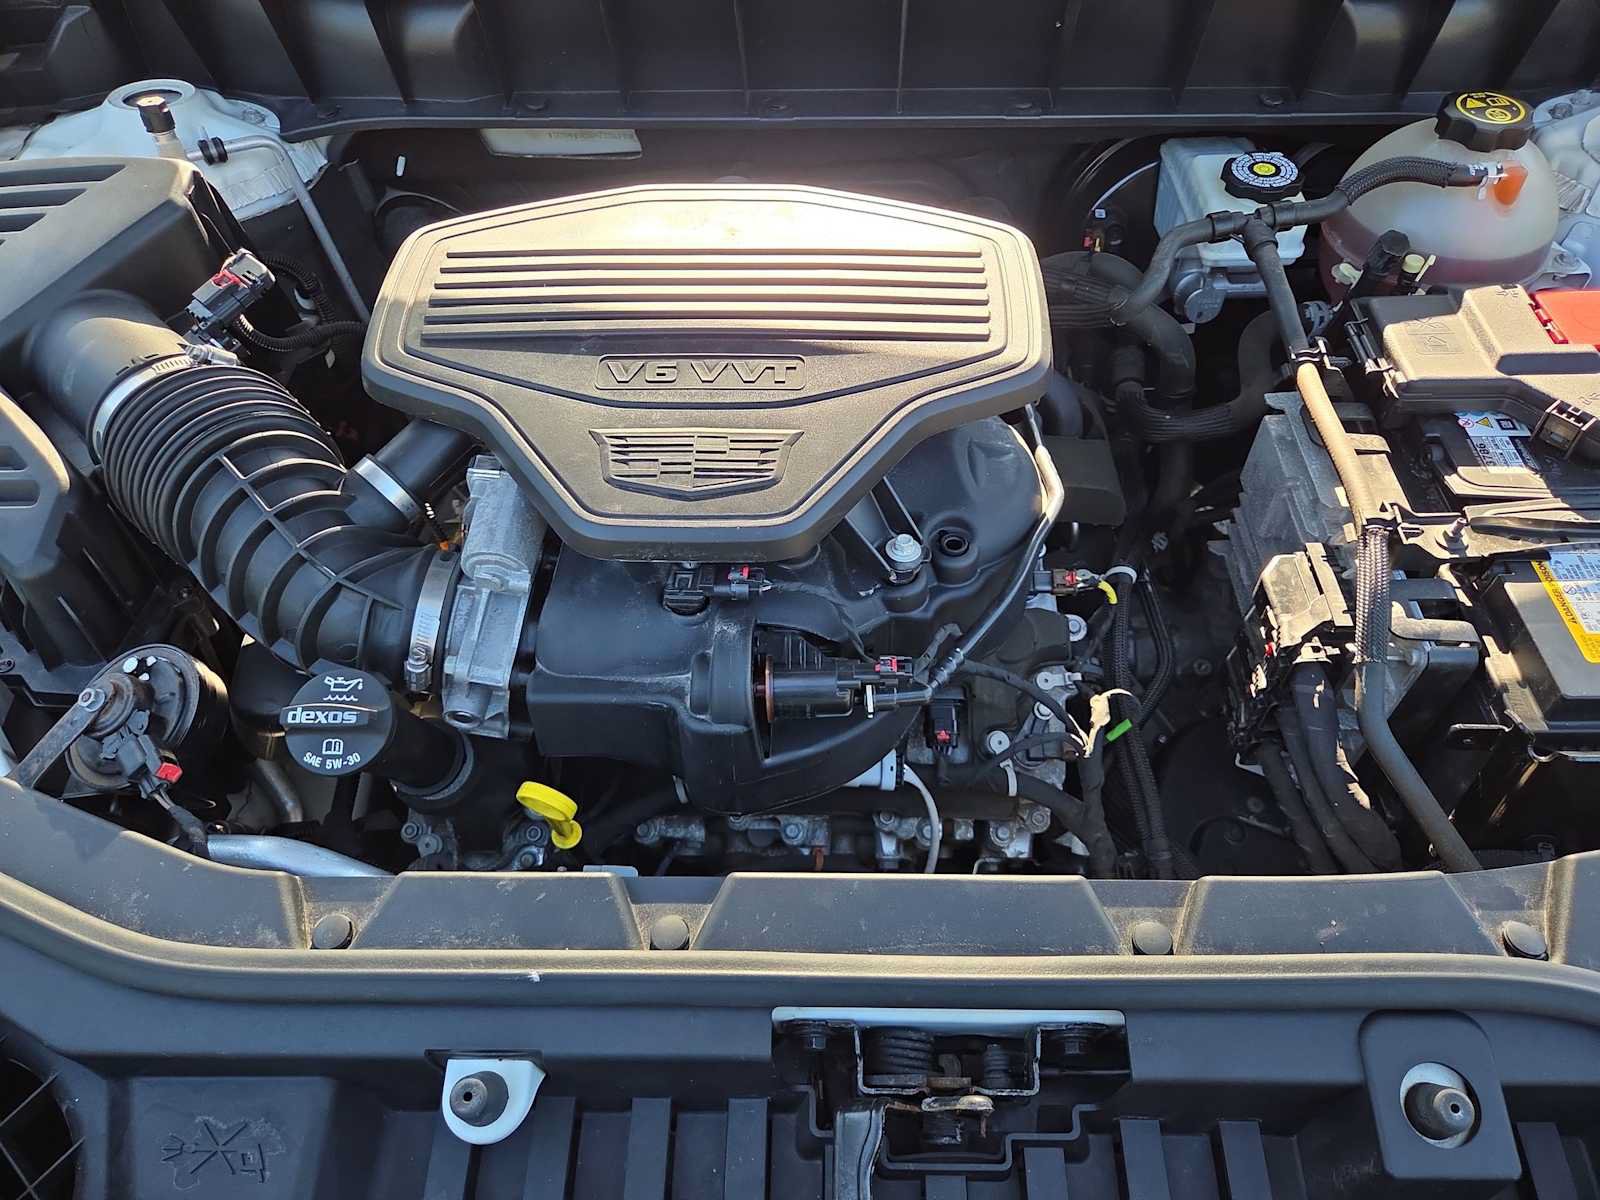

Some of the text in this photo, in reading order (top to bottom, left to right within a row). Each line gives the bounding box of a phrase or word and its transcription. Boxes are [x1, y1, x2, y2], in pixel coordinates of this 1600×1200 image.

[607, 361, 798, 385] V6 VVT
[286, 706, 359, 724] dexos
[303, 751, 361, 770] SAE 5W-30
